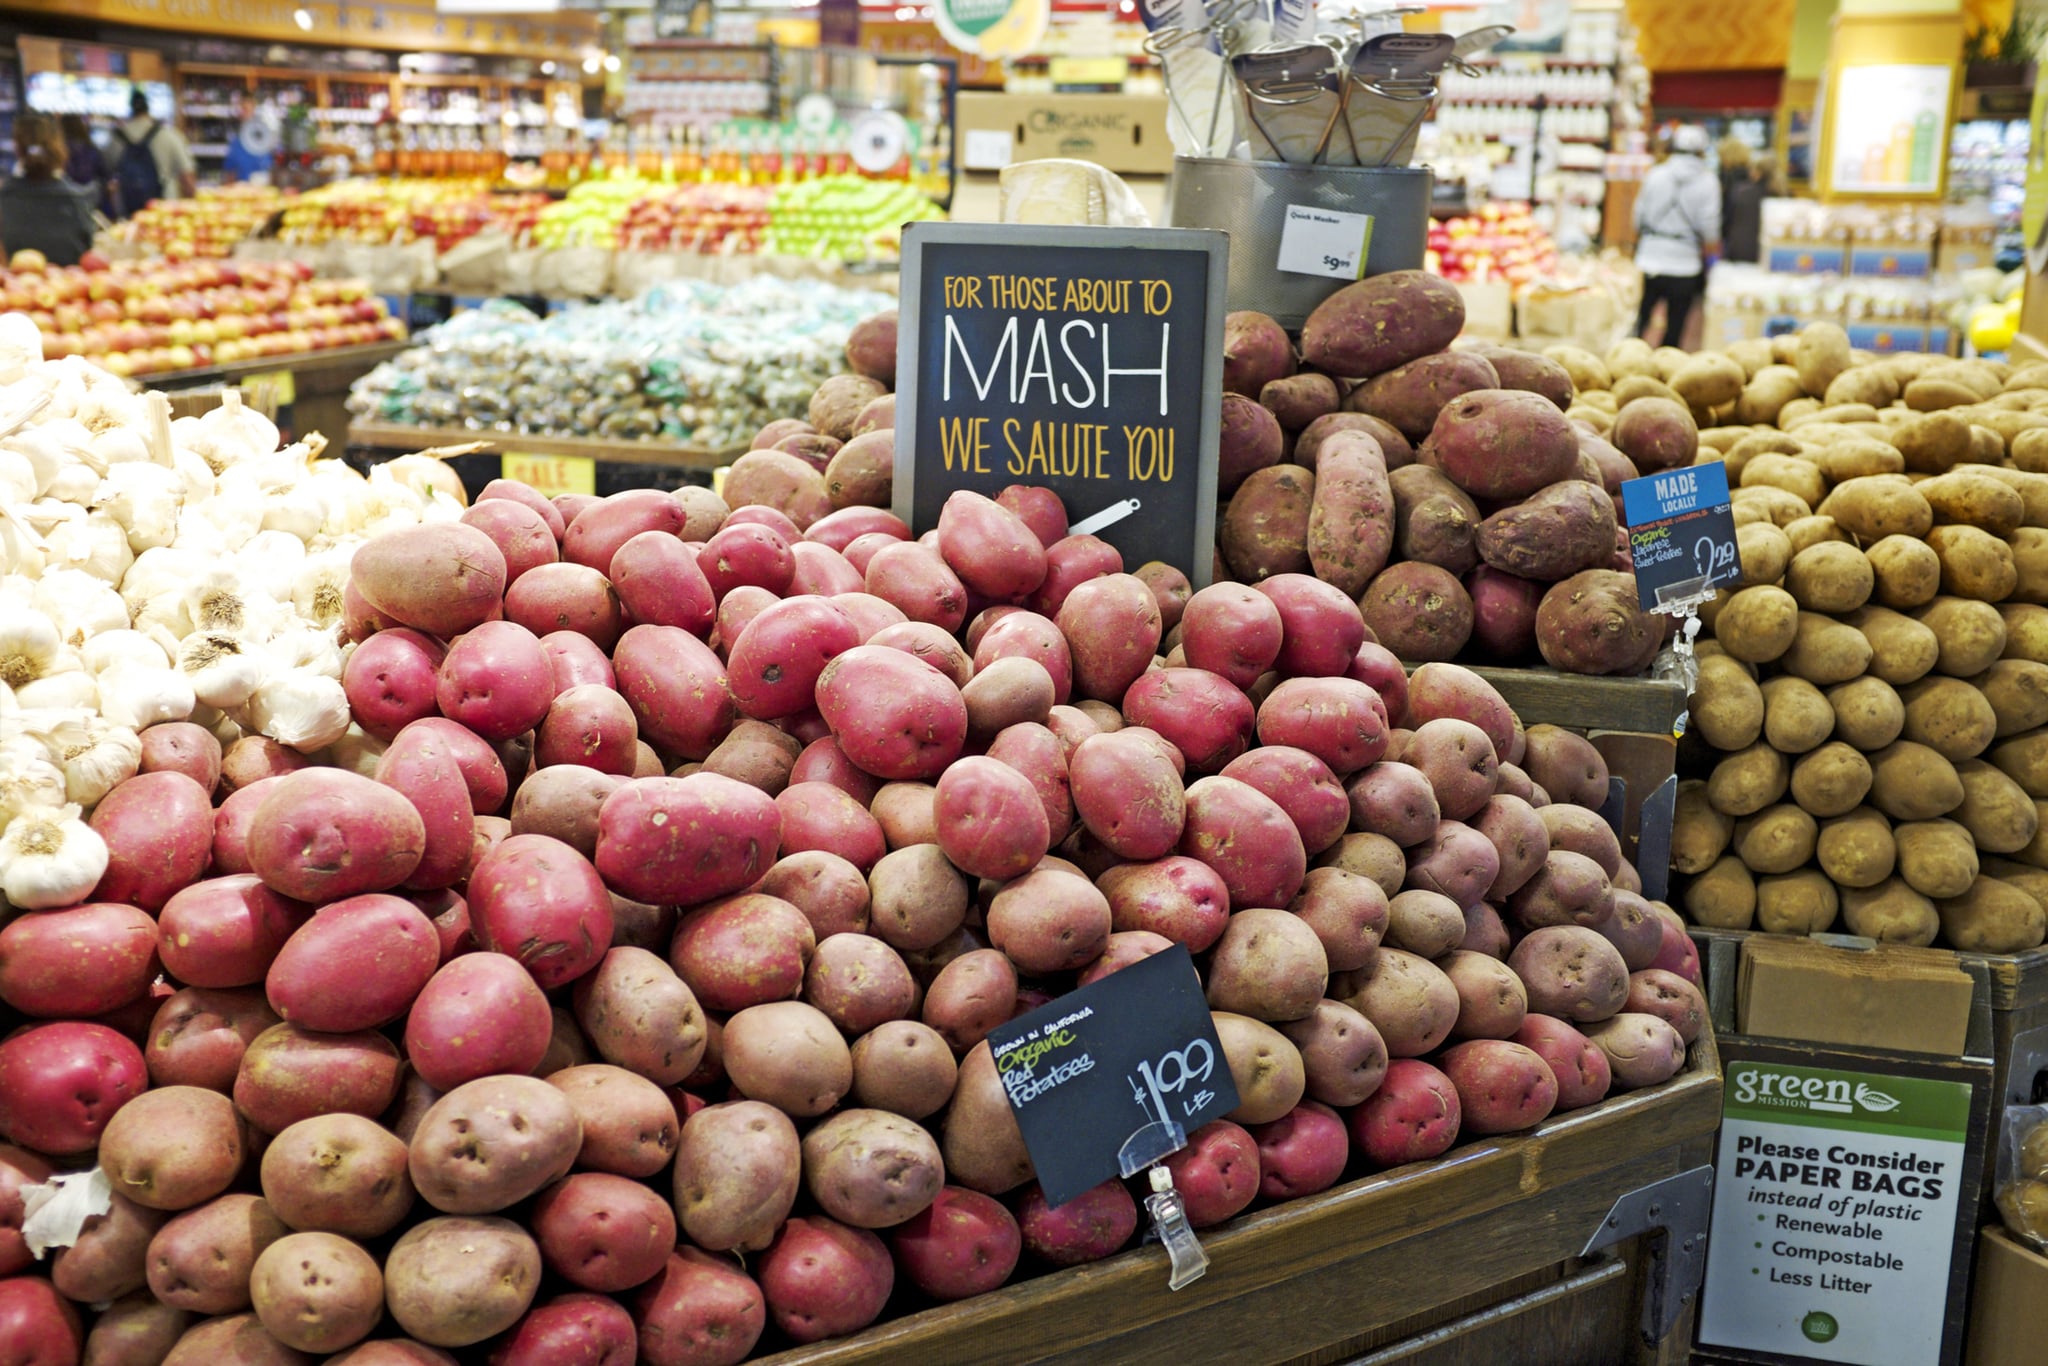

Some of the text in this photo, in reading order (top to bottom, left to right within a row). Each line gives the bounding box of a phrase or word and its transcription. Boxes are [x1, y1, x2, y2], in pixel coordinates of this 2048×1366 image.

[1290, 211, 1311, 220] Quick
[944, 275, 1172, 316] FOR THOSE ABOUT TO
[943, 315, 1170, 416] MASH
[939, 417, 1174, 482] WE SALUTE YOU
[514, 461, 568, 489] SALE
[1654, 472, 1698, 501] MADE
[1662, 495, 1697, 514] LOCALLY
[1631, 527, 1672, 547] Organic
[993, 1006, 1094, 1059] GROWN IN CALIFORNIA
[1002, 1061, 1034, 1091] Red
[1010, 1053, 1095, 1108] Potatoes
[1734, 1069, 1853, 1104] green
[1183, 1089, 1215, 1117] LB
[1757, 1096, 1808, 1109] MISSION
[1737, 1136, 1945, 1175] Please Consider
[1735, 1159, 1943, 1200] PAPER BAGS
[1747, 1186, 1923, 1222] instead of plastic
[1775, 1214, 1883, 1240] Renewable
[1772, 1241, 1904, 1271] Compostable
[1769, 1268, 1872, 1295] Less Litter
